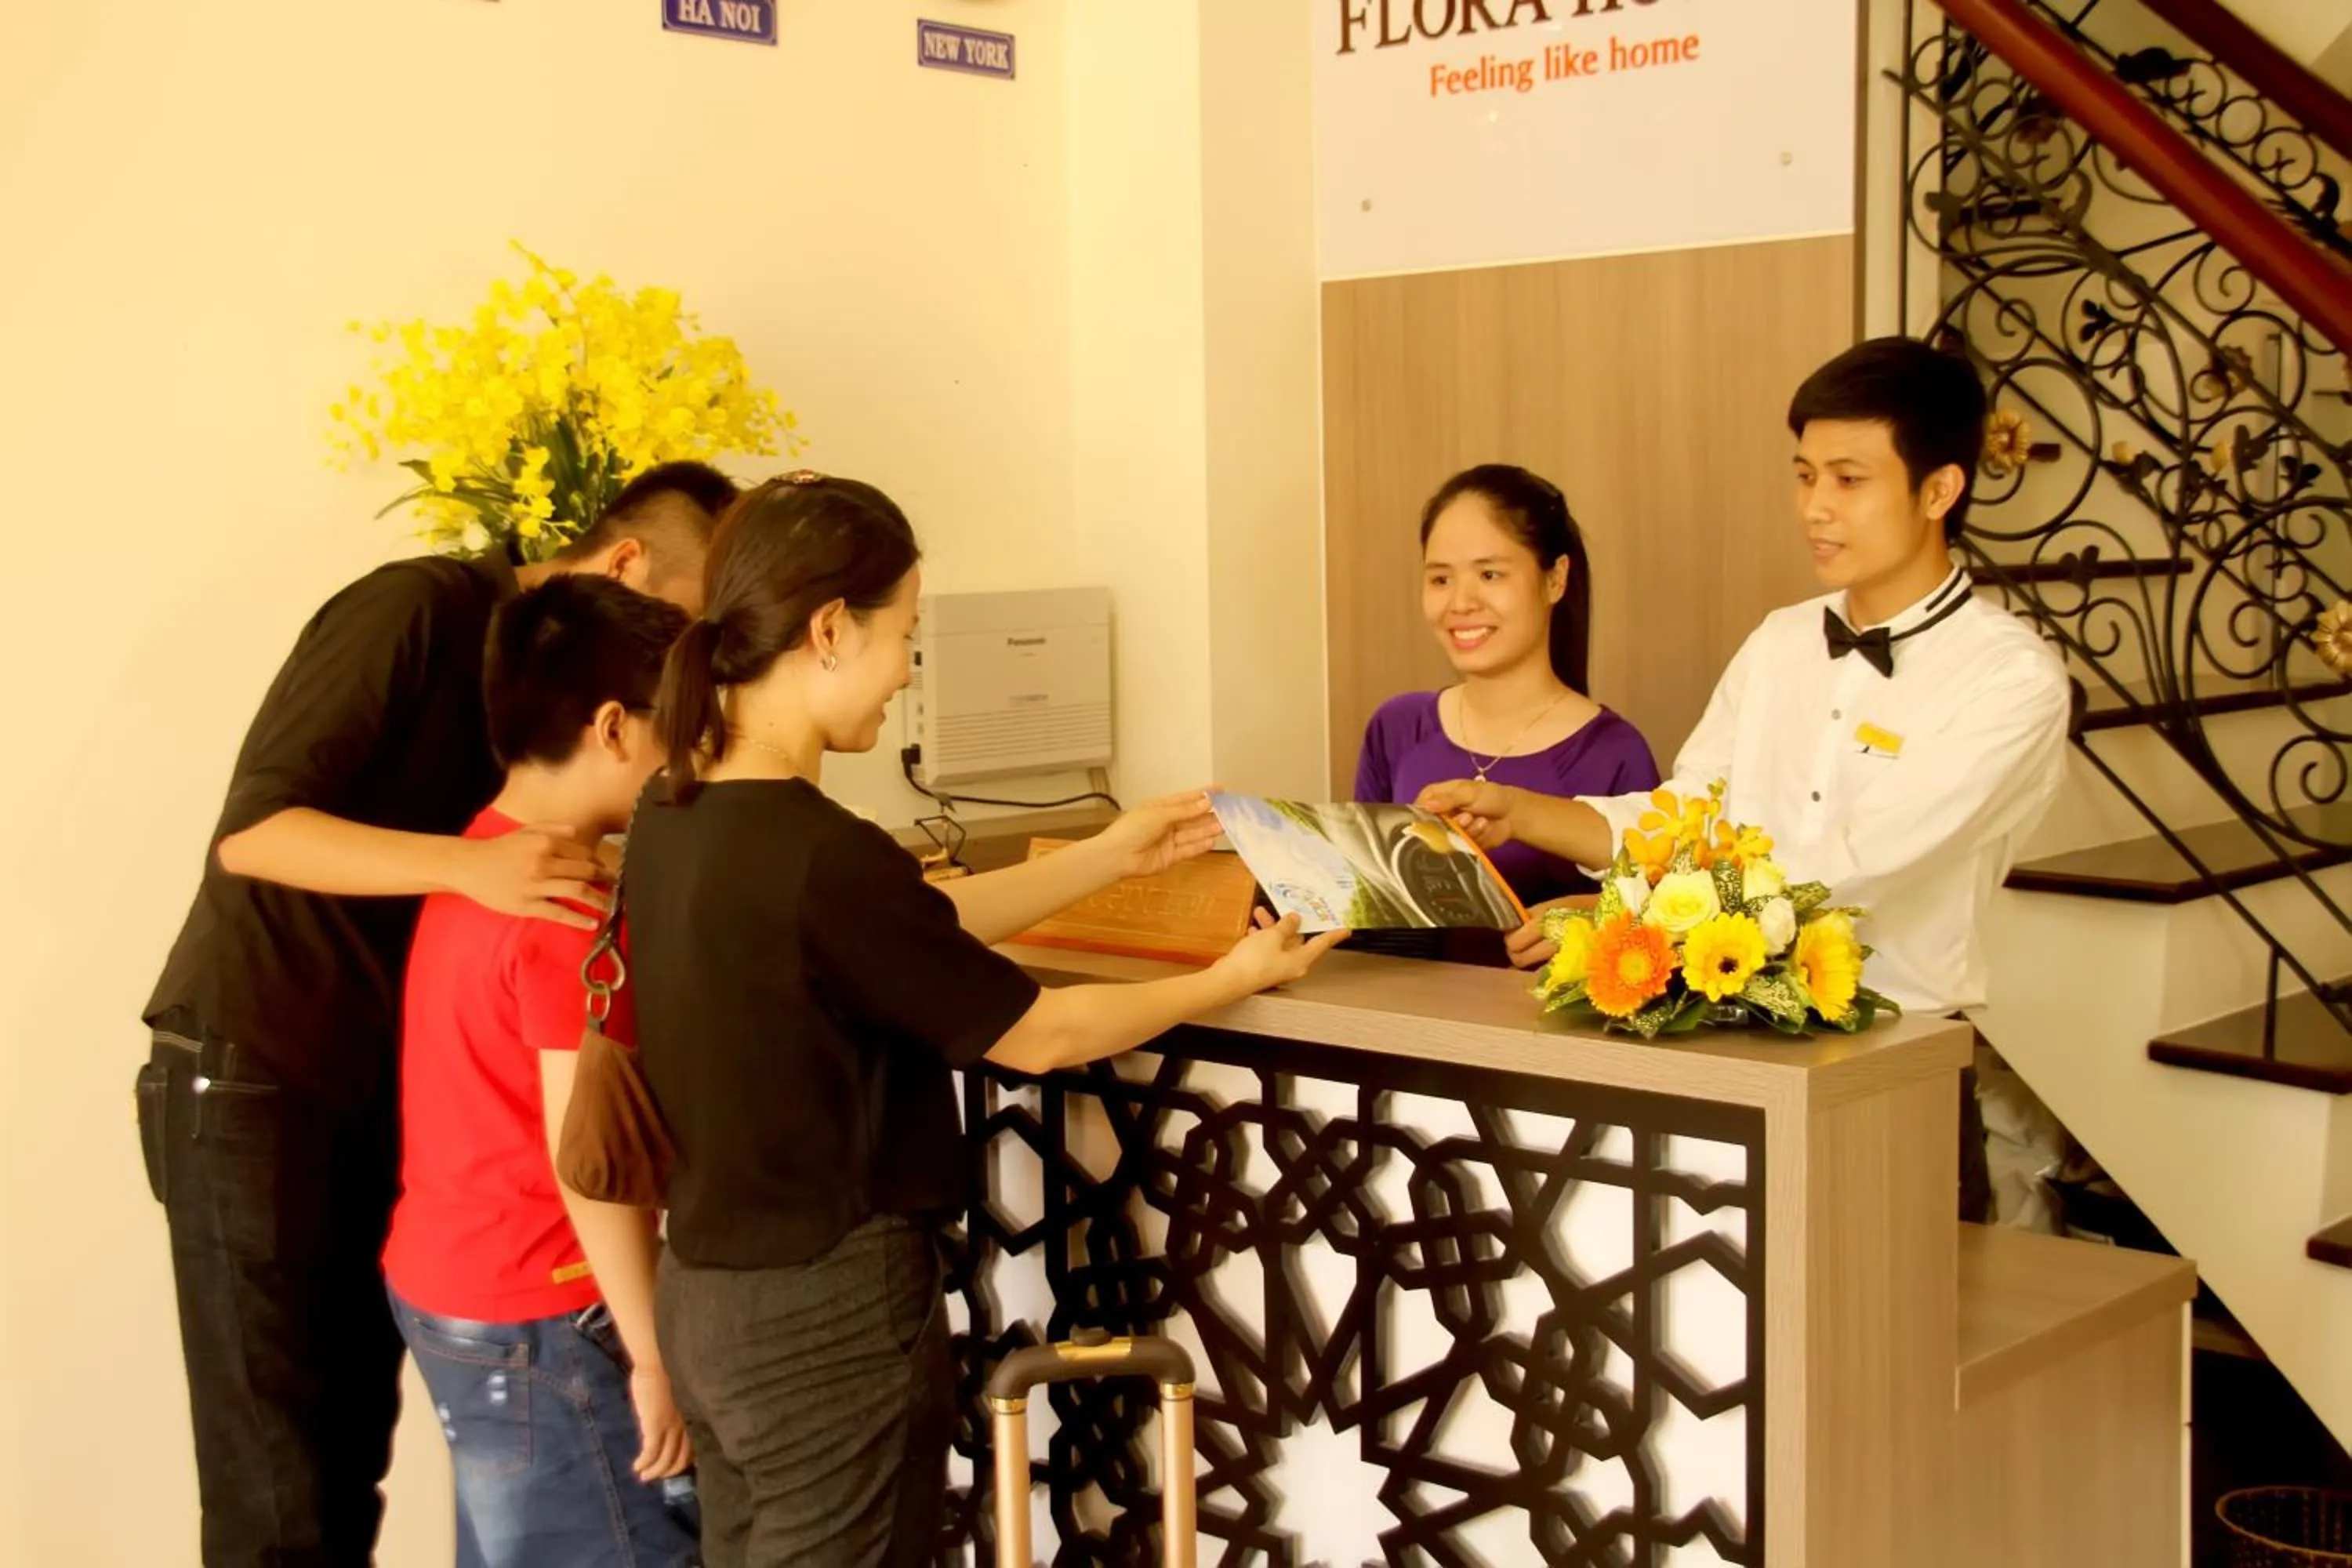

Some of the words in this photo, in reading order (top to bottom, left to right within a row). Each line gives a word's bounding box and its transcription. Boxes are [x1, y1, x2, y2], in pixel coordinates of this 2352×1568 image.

[678, 0, 716, 26] HA
[719, 1, 761, 33] NOI
[924, 31, 961, 62] NEW
[964, 38, 1010, 70] YORK
[1430, 56, 1535, 98] Feeling
[1544, 43, 1599, 81] like
[1610, 34, 1700, 71] home
